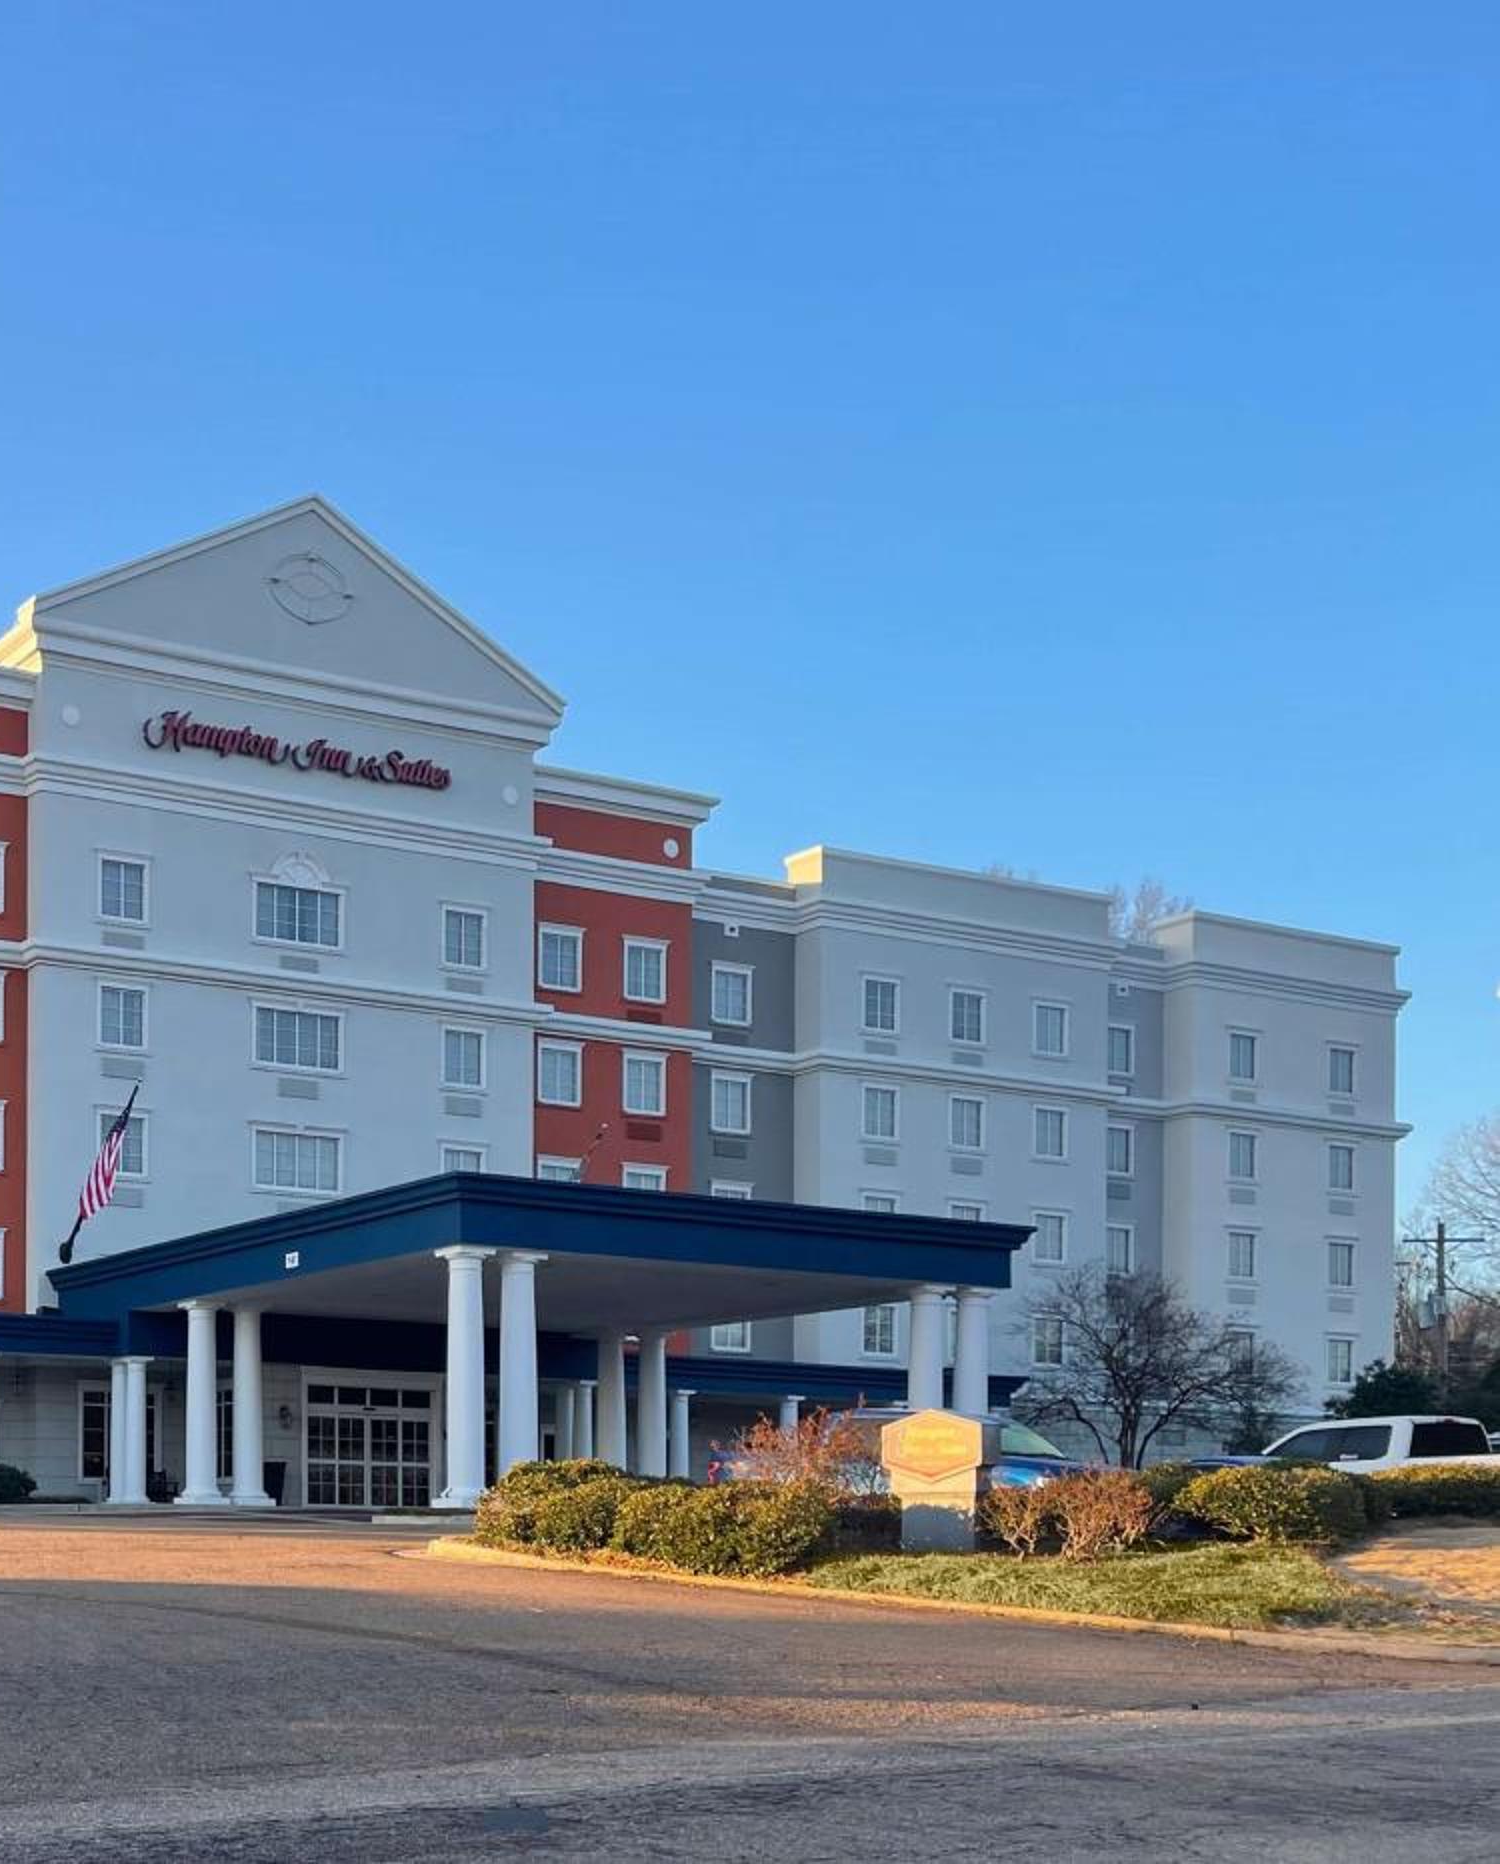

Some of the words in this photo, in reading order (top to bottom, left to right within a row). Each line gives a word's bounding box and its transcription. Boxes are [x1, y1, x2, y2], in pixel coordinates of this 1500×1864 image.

[143, 710, 290, 765] Hampton
[292, 739, 363, 778] Inn
[378, 750, 452, 791] Suites
